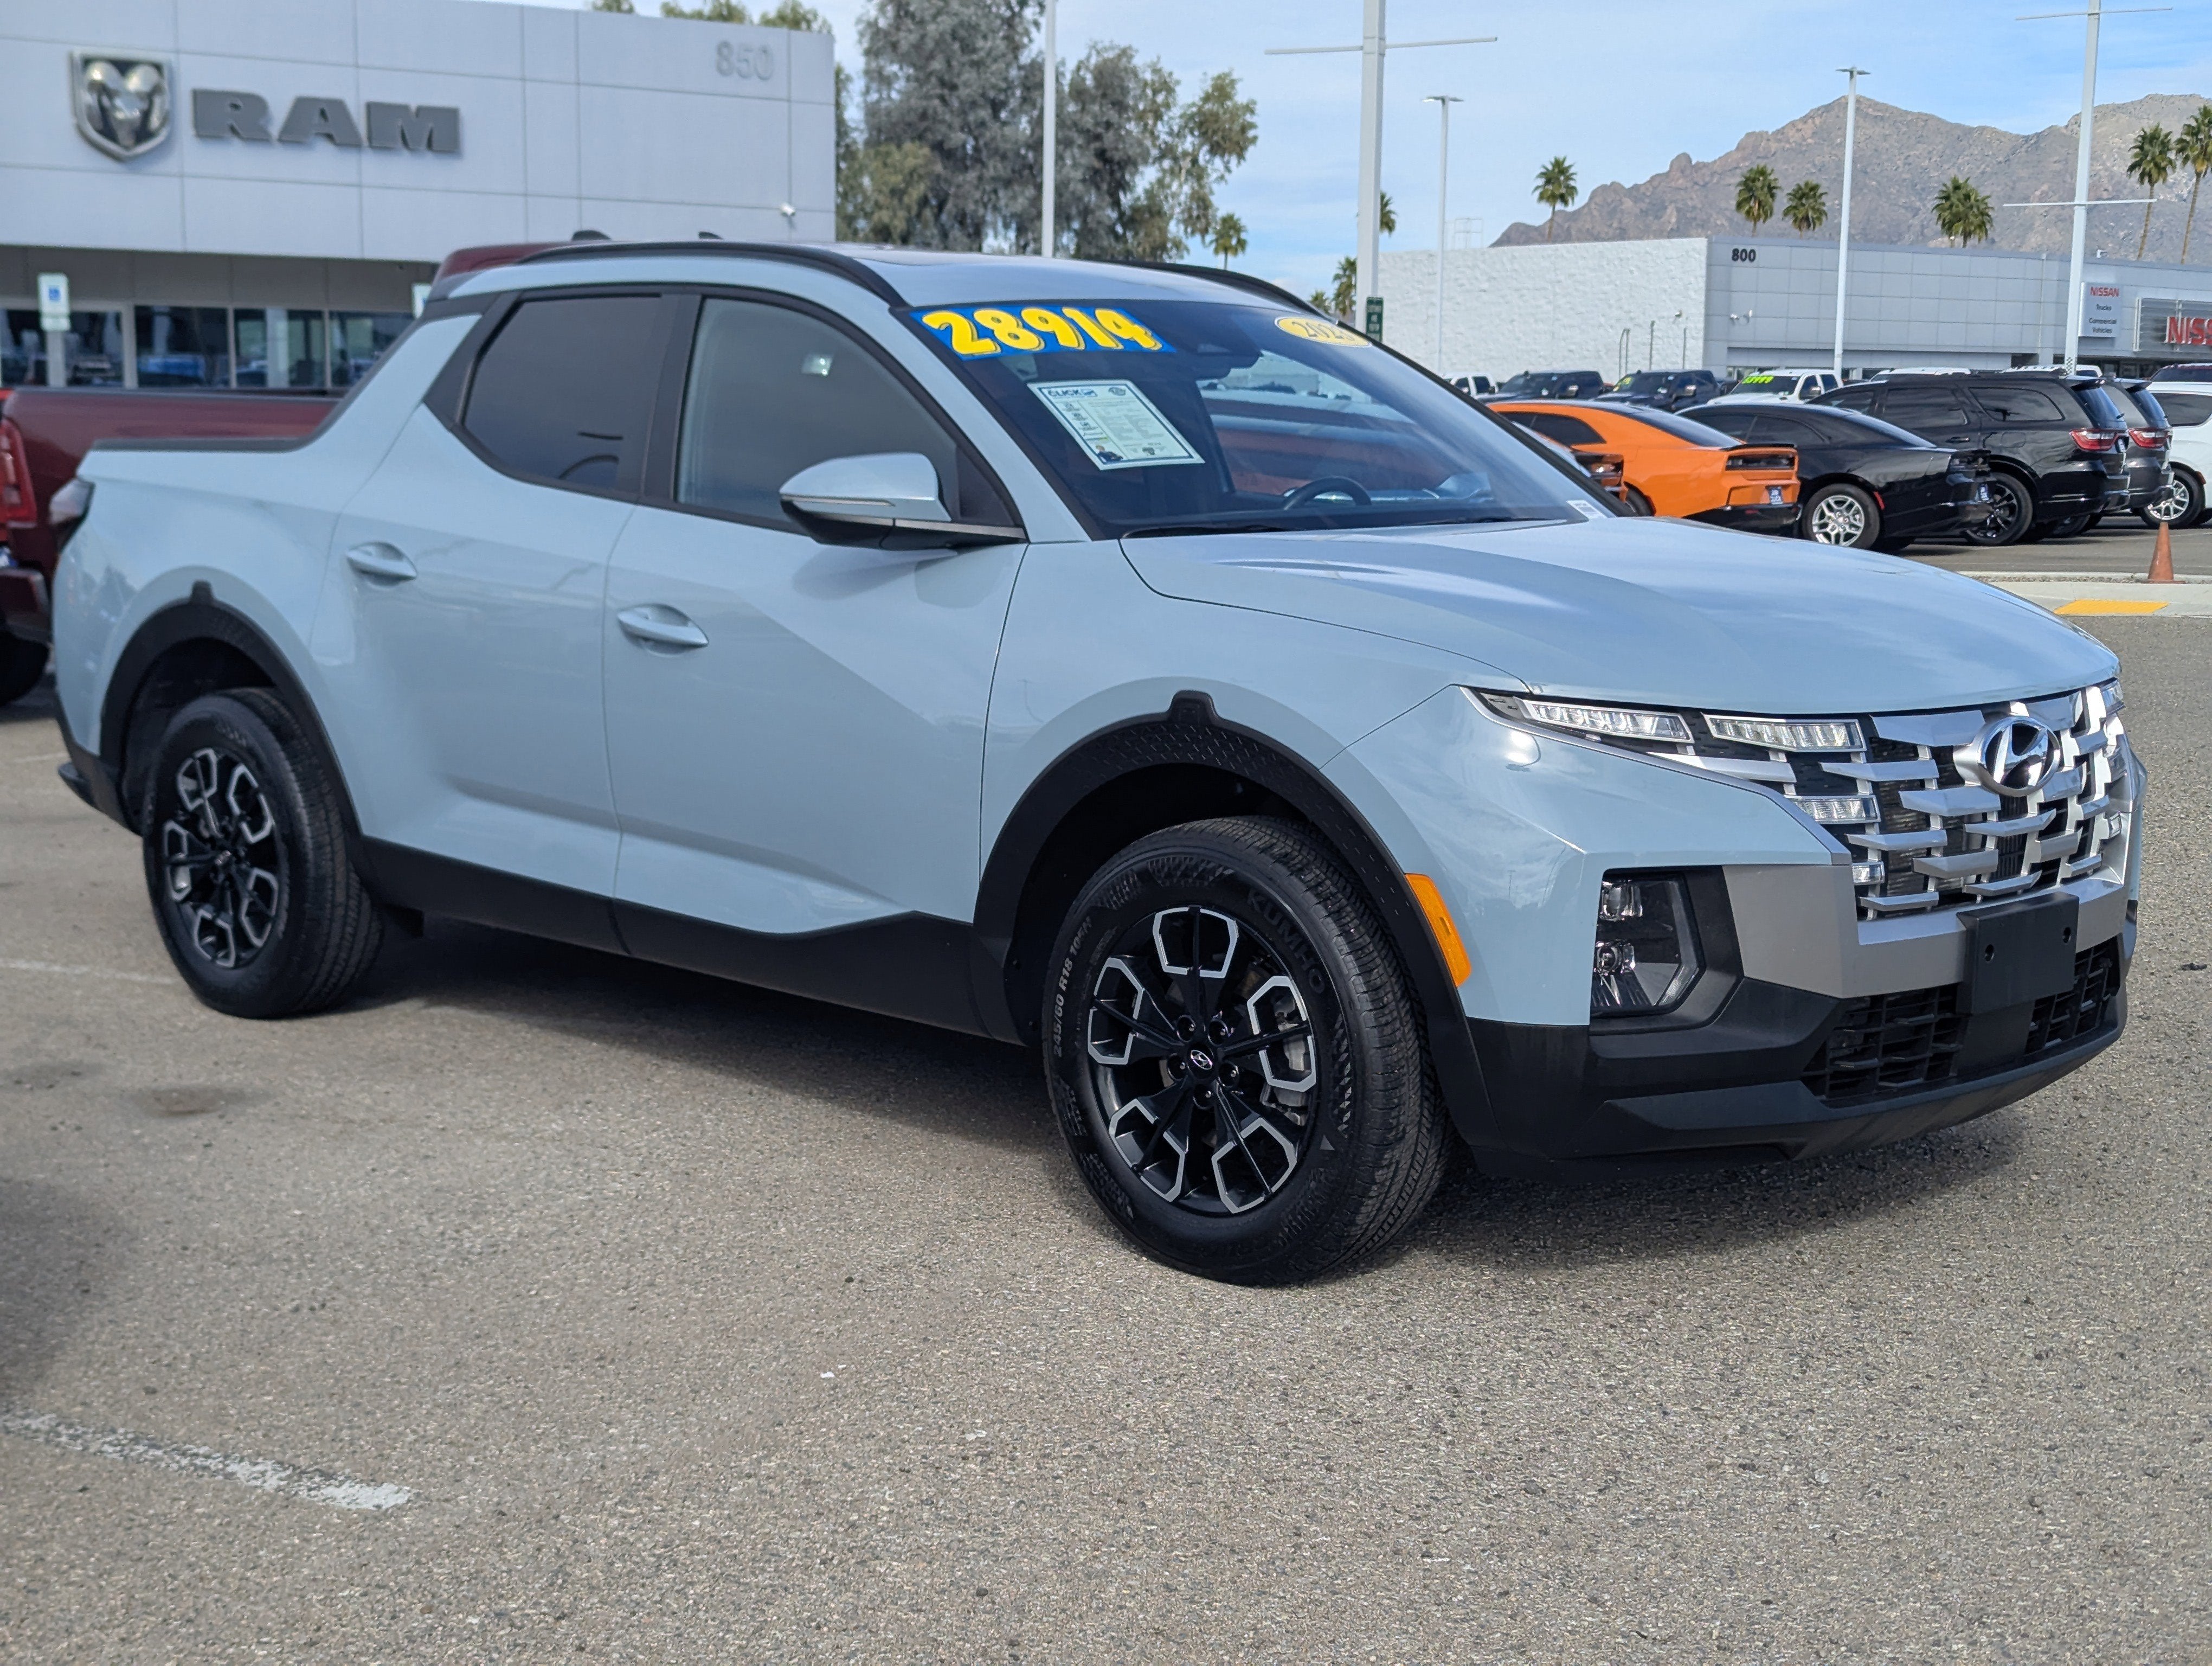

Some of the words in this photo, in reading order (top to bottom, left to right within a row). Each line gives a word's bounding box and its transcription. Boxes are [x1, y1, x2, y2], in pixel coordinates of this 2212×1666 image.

[716, 41, 774, 81] 850
[191, 88, 460, 153] RAM
[1731, 248, 1756, 262] 800
[2091, 286, 2119, 297] NISSAN
[922, 307, 1162, 354] 28914
[1248, 888, 1326, 994] KUMHO
[1053, 994, 1064, 1058] 245/60
[1059, 957, 1073, 991] R18
